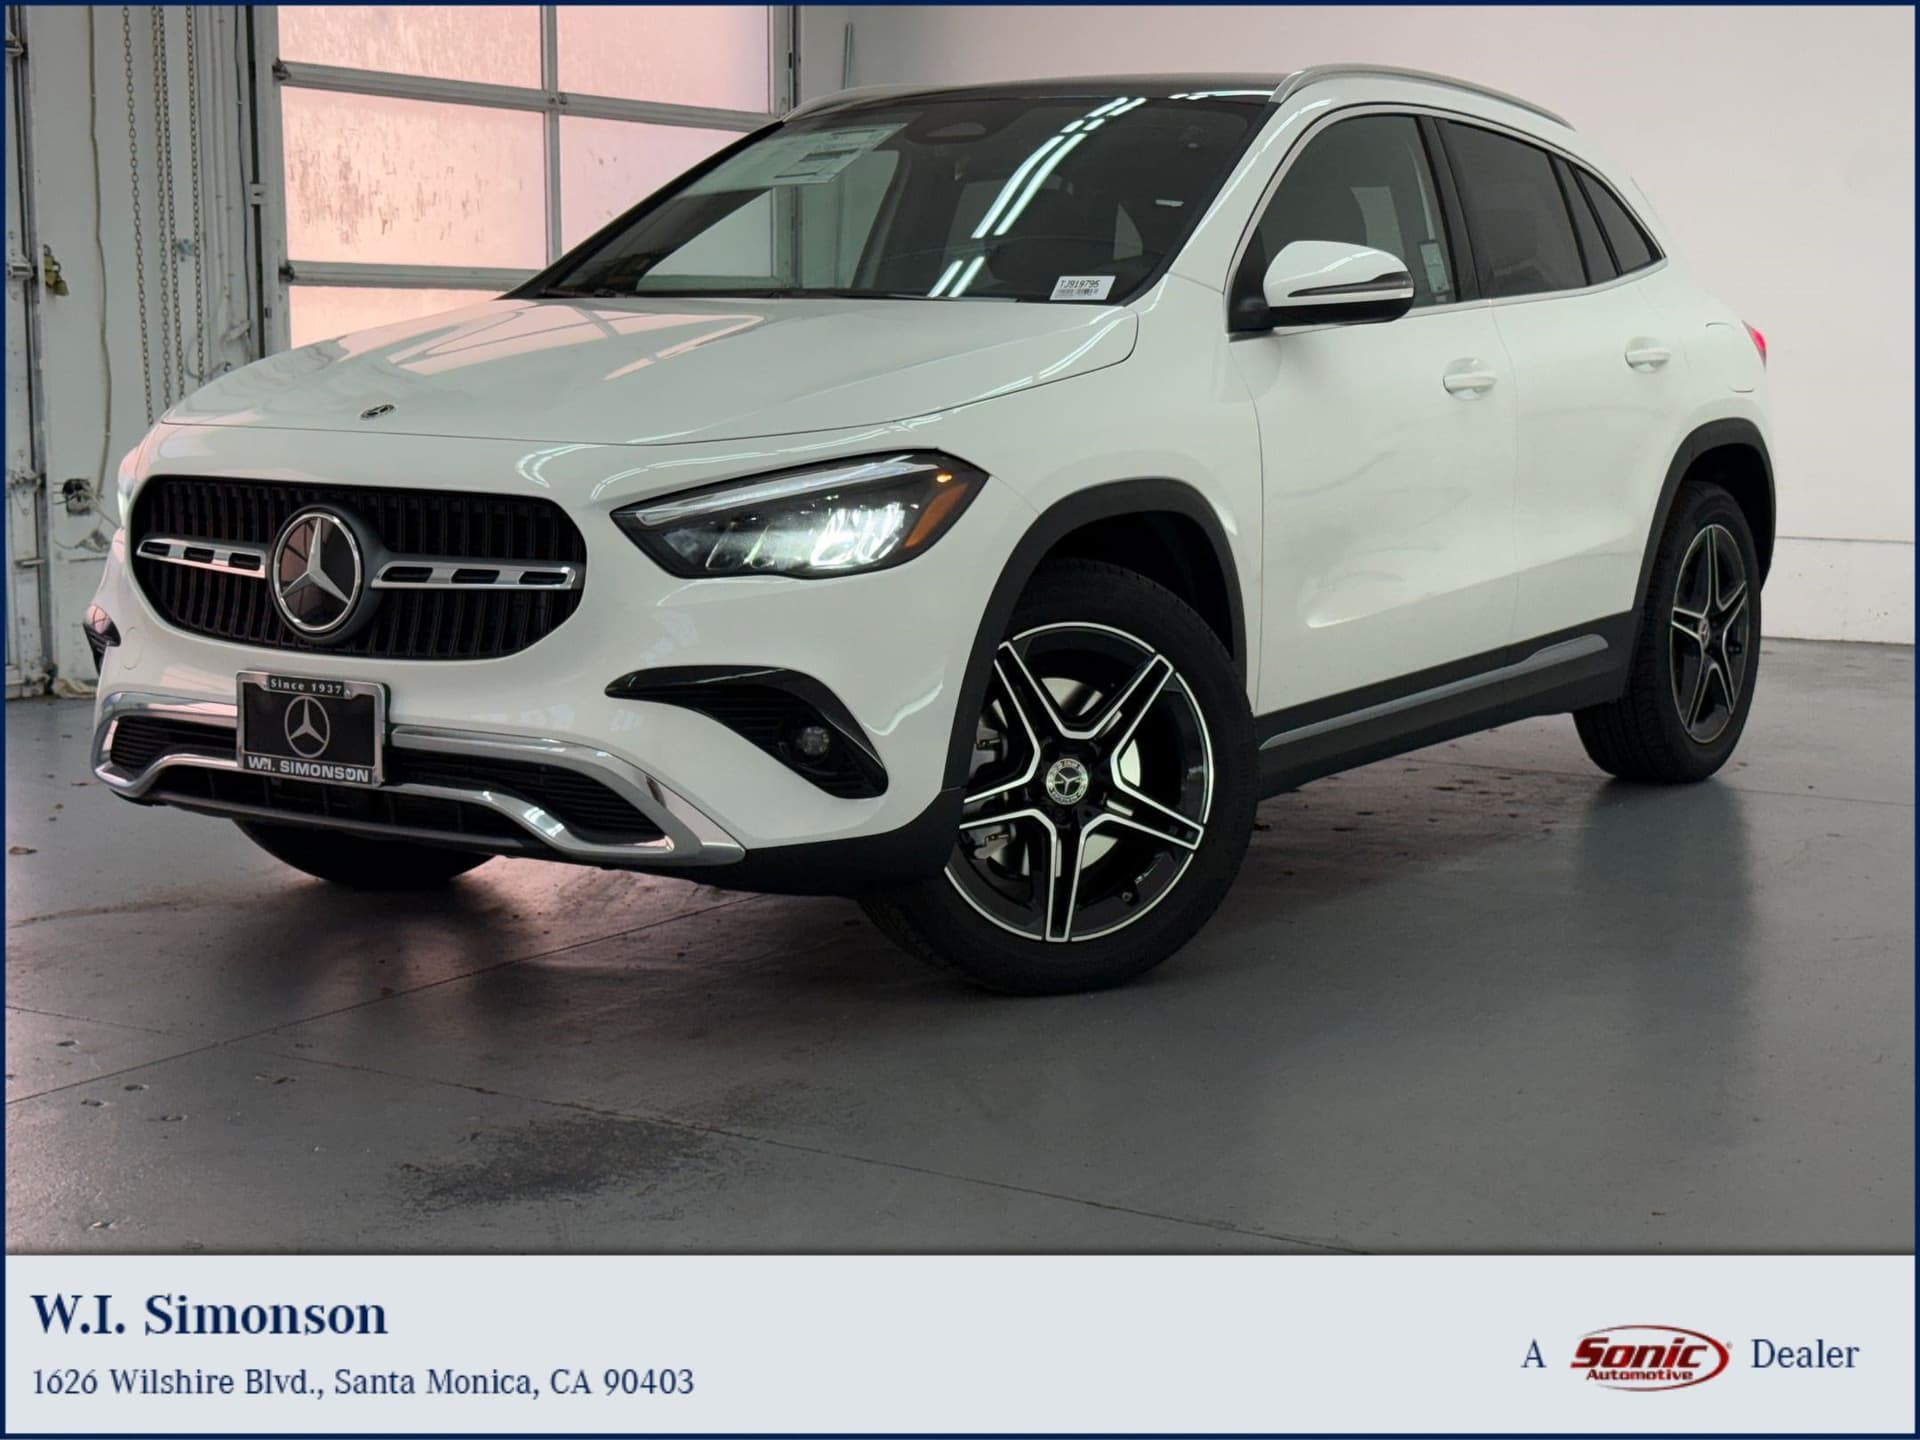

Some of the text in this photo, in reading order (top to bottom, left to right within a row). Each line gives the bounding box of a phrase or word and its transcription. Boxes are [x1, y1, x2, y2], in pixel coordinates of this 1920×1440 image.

[270, 678, 342, 694] Since 1937
[279, 760, 369, 783] SIMONSON
